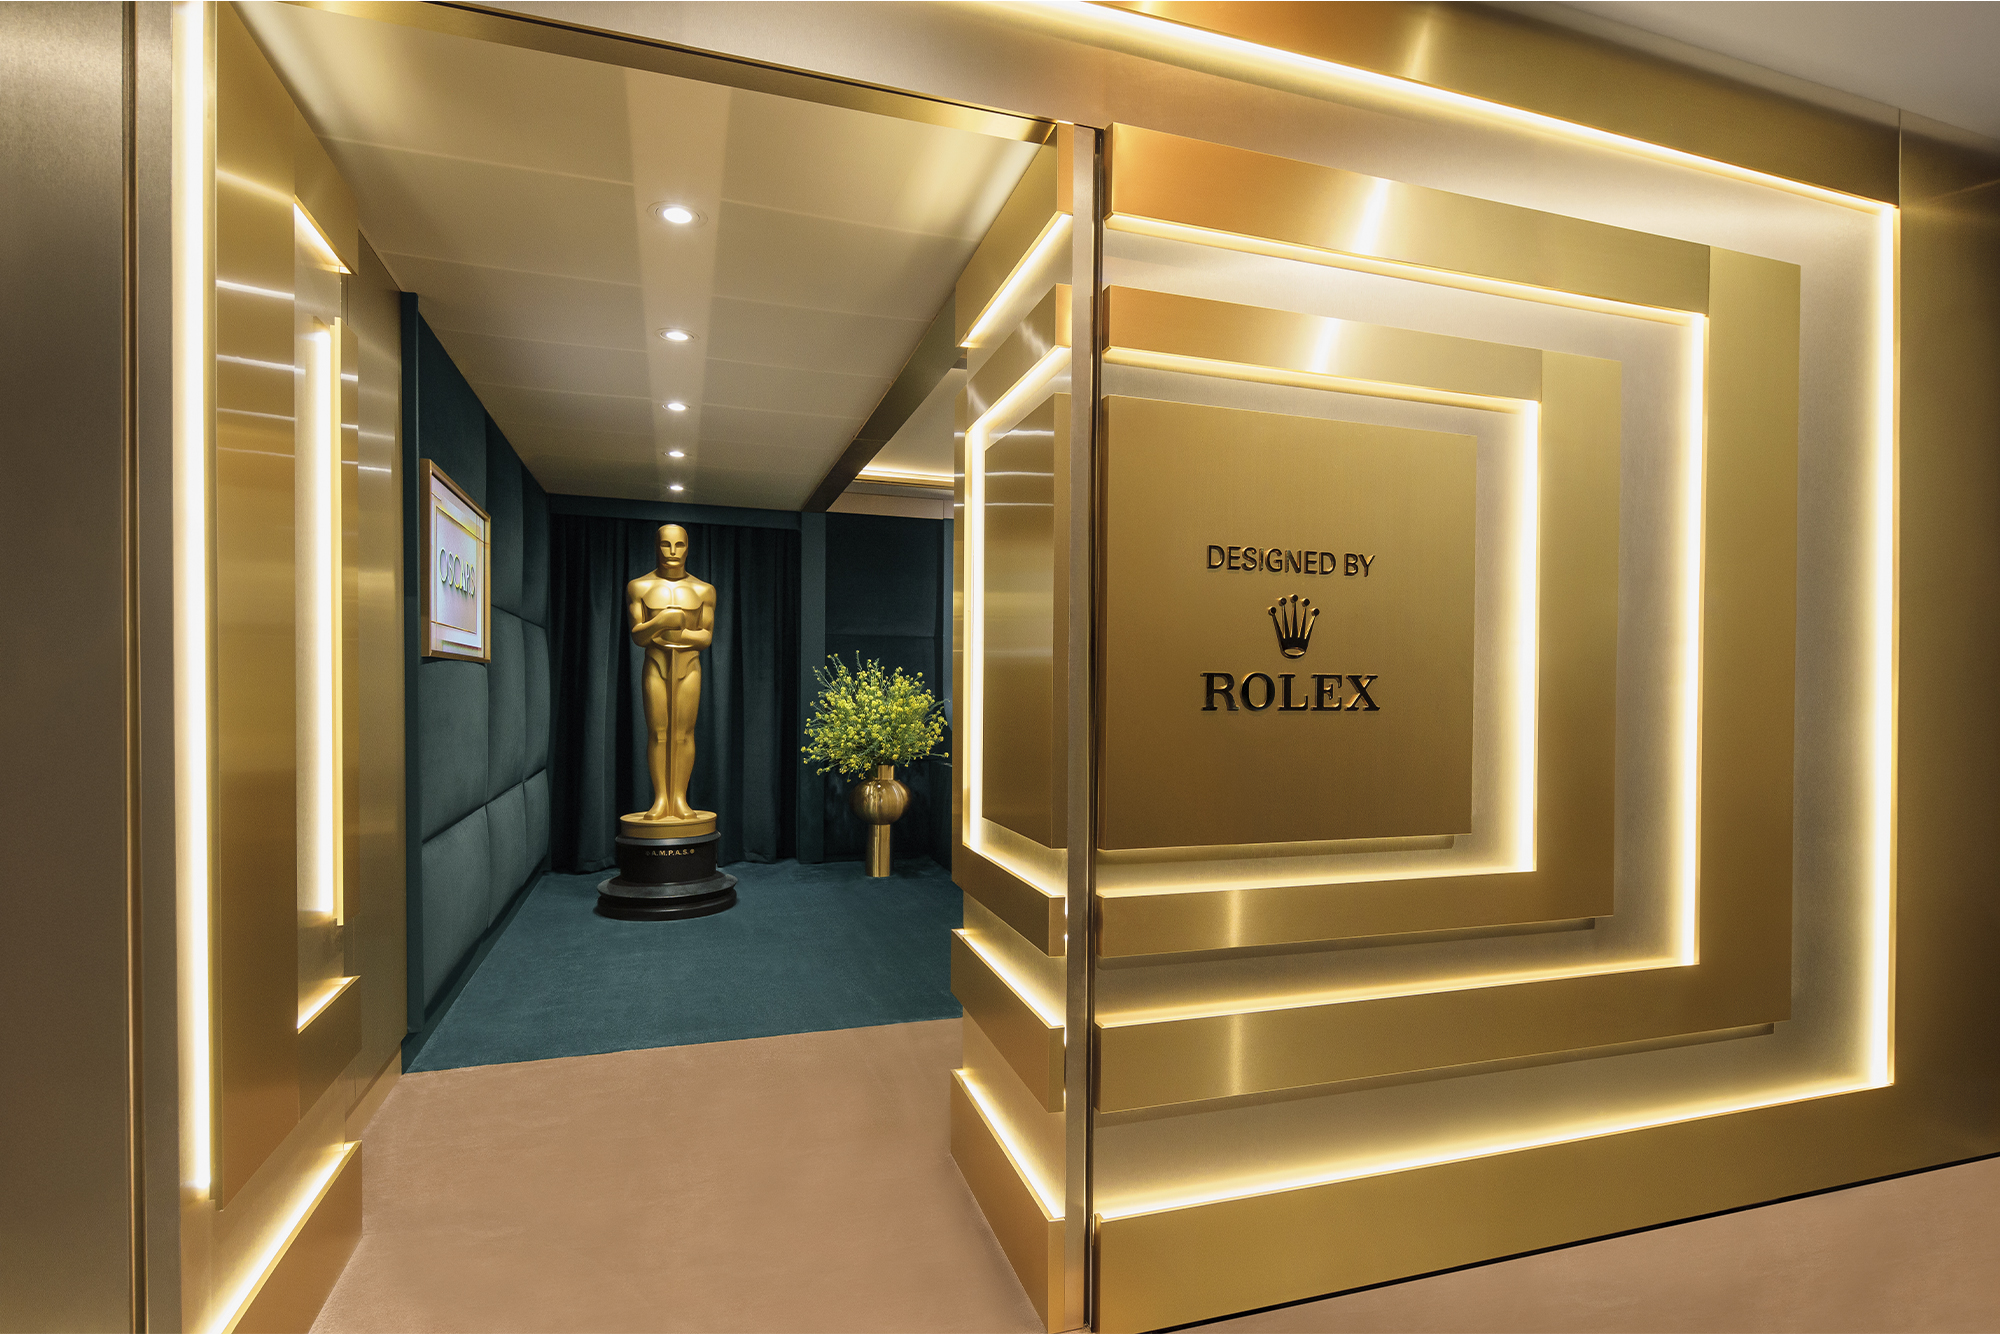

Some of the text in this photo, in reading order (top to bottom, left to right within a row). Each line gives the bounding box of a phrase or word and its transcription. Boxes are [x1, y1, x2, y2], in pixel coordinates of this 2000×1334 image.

[439, 547, 476, 599] OSCARS
[1206, 544, 1376, 577] DESIGNED BY
[1200, 671, 1380, 712] ROLEX
